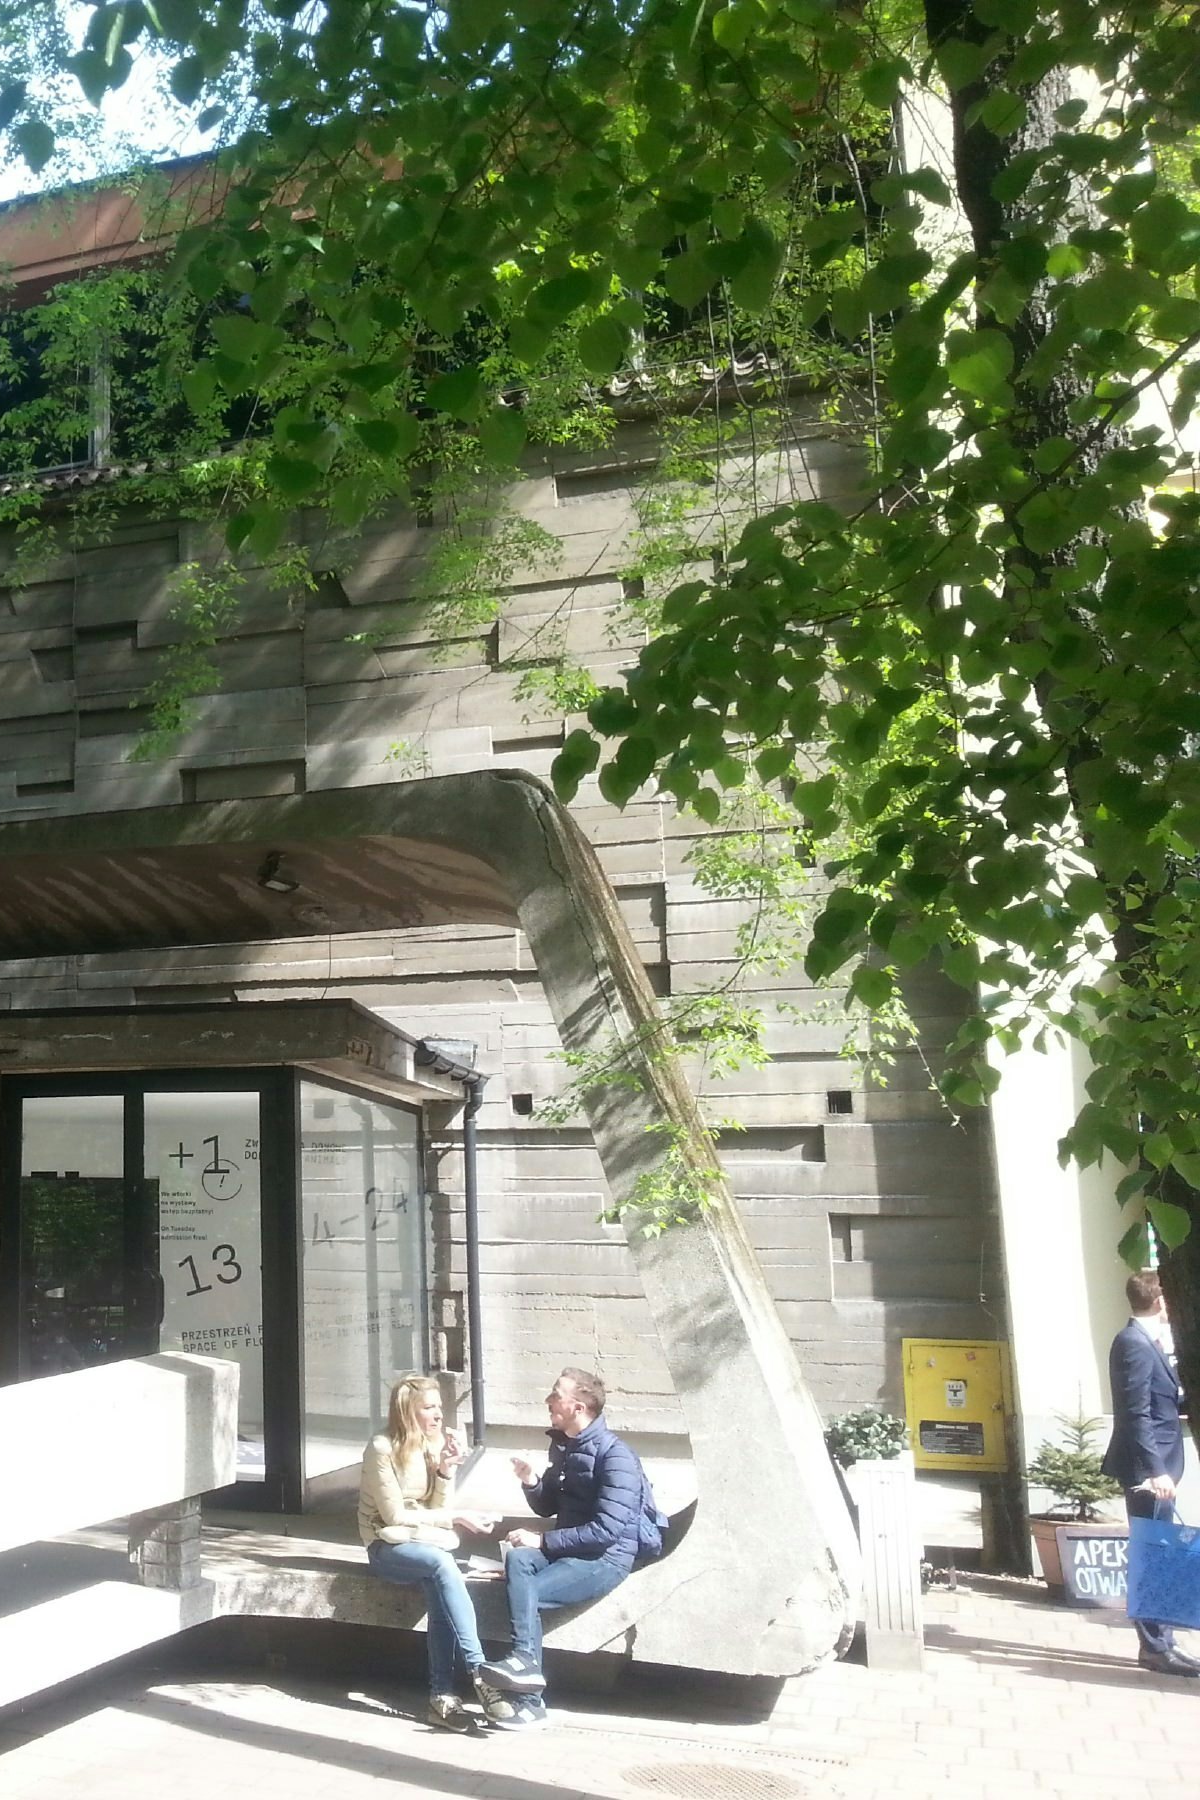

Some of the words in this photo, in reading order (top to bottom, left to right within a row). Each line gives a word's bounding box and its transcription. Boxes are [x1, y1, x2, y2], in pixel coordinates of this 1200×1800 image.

[183, 1341, 217, 1353] SPACE
[224, 1339, 238, 1349] OF
[1074, 1540, 1130, 1567] APER
[1075, 1567, 1128, 1597] OTWA
